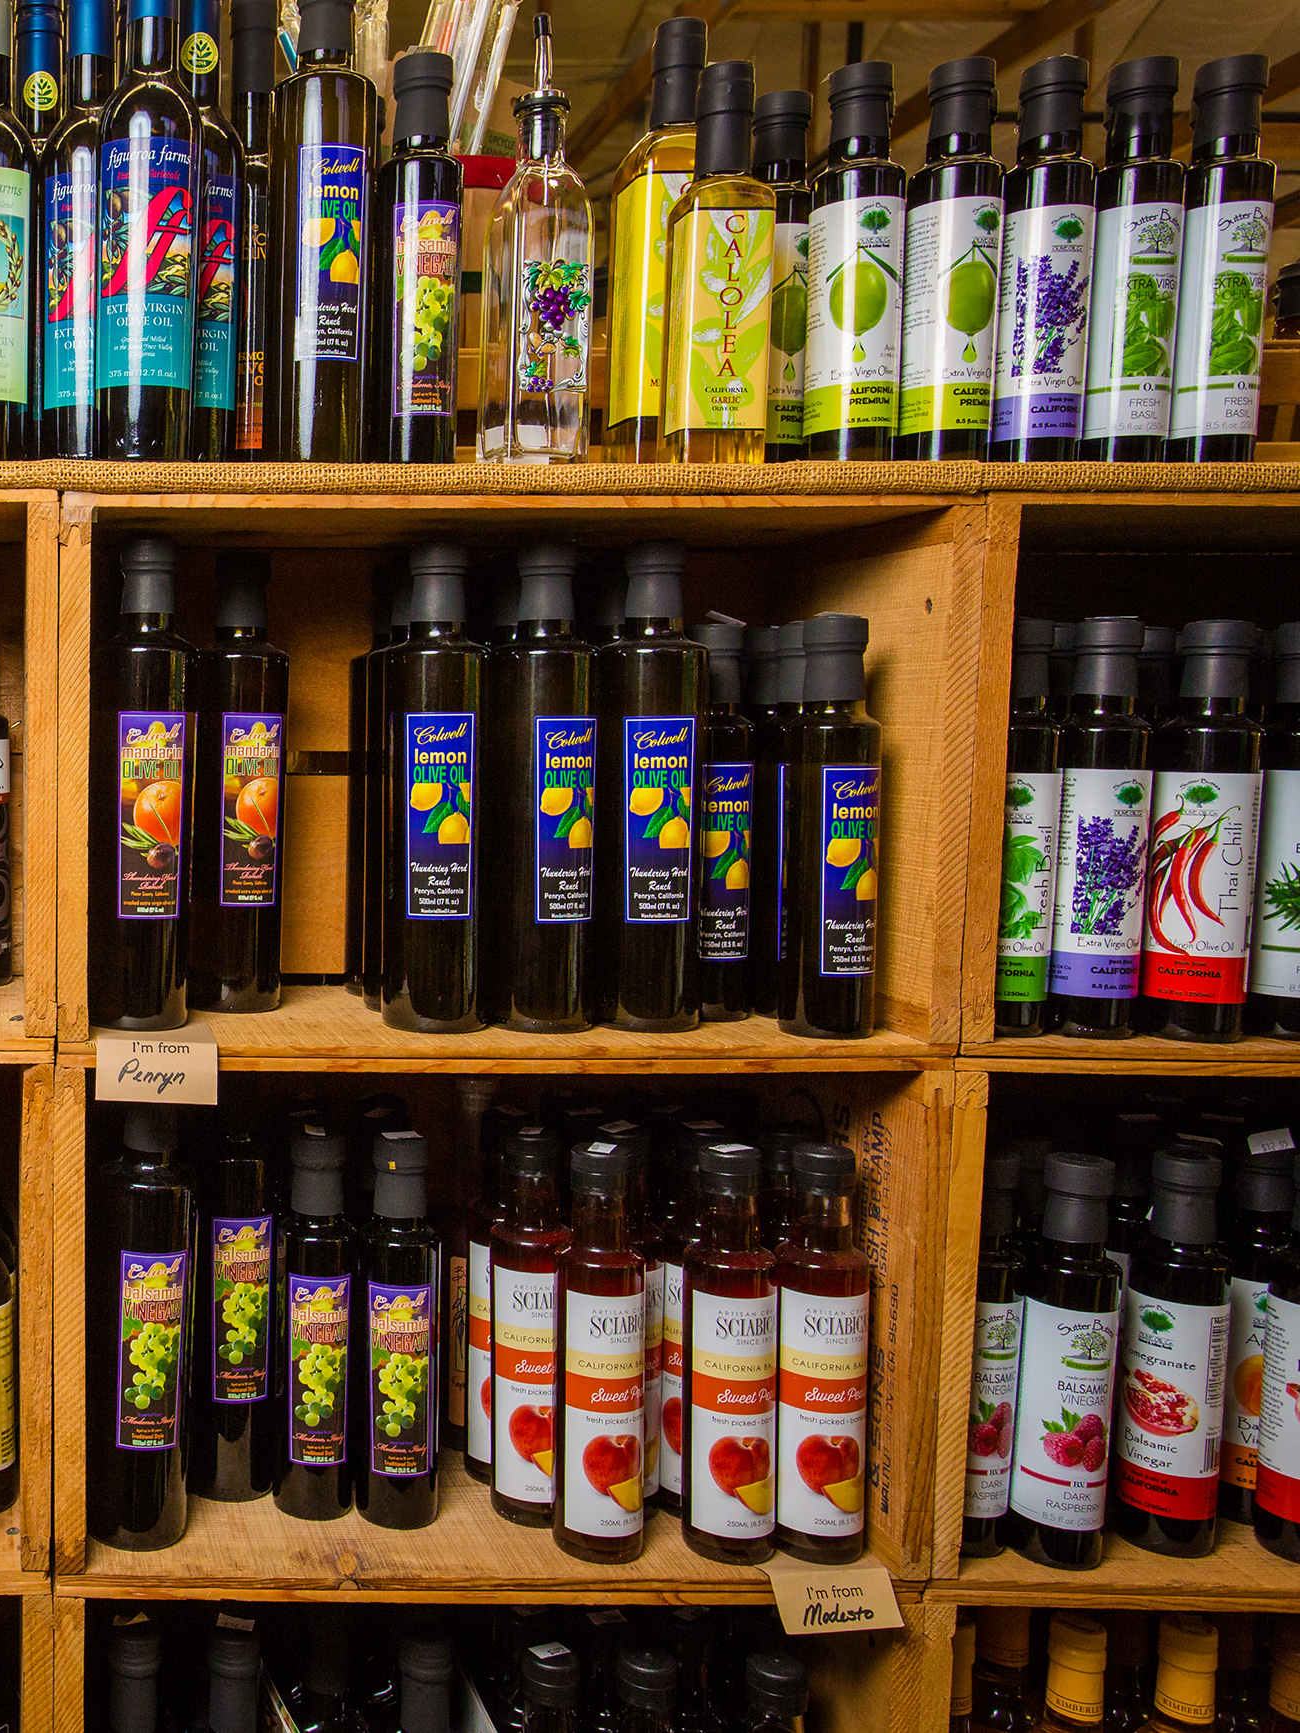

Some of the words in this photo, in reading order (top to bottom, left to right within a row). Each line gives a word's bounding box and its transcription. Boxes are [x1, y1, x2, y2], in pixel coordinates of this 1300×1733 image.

[107, 148, 155, 171] figueroa
[157, 144, 191, 165] farms
[308, 158, 359, 179] Colwell
[308, 182, 359, 200] lemon
[400, 209, 454, 233] Colwell
[1124, 215, 1157, 233] Sutter
[397, 237, 456, 255] balsamic
[397, 253, 455, 276] VINEGAR
[716, 214, 745, 378] CALOLEA
[106, 304, 139, 315] EXTRA
[143, 304, 183, 315] VIRGIN
[116, 316, 150, 327] OLIVE
[153, 315, 173, 327] OIL
[705, 386, 748, 394] CALIFORNIA
[842, 386, 894, 397] CALIFORNIA
[711, 395, 741, 405] GARLIC
[849, 397, 890, 406] PREMIUM
[1129, 398, 1160, 408] FRESH
[1130, 409, 1157, 420] BASIL
[126, 727, 180, 745] Colwell
[414, 722, 467, 746] Colwell
[122, 745, 182, 759] mandarin
[414, 748, 467, 764] lemon
[123, 759, 160, 779] OLIVE
[163, 759, 181, 779] OIL
[413, 765, 447, 784] OLIVE
[450, 765, 468, 784] OIL
[1035, 826, 1052, 870] Basil
[1221, 821, 1243, 867] Chili
[410, 862, 449, 875] Thundering
[451, 862, 468, 874] Herd
[428, 875, 451, 887] Ranch
[414, 887, 435, 896] Penryn,
[438, 887, 464, 895] California
[1218, 873, 1239, 916] Thai
[418, 897, 437, 906] 500ml
[1158, 966, 1222, 979] CALIFORNIA
[132, 1041, 154, 1054] I'm
[158, 1041, 190, 1055] from
[117, 1058, 185, 1095] Penryn
[127, 1258, 183, 1279] Colwell
[122, 1284, 183, 1301] balsamic
[123, 1301, 181, 1321] VINEGAR
[717, 1310, 753, 1318] ARTISAN
[704, 1359, 760, 1372] CALIFORNIA
[1057, 1380, 1109, 1395] BALSAMIC
[716, 1388, 757, 1404] Sweet
[1060, 1393, 1106, 1407] VINEGAR
[711, 1416, 730, 1425] fresh
[731, 1416, 756, 1427] picked
[1124, 1426, 1178, 1455] Balsamic
[1125, 1443, 1173, 1470] Vinegar
[1063, 1491, 1091, 1502] DARK
[1045, 1499, 1099, 1513] RASPBERRY
[726, 1518, 750, 1529] 250ML
[806, 1586, 827, 1599] I'm
[831, 1585, 864, 1599] from
[803, 1605, 875, 1628] Modesto
